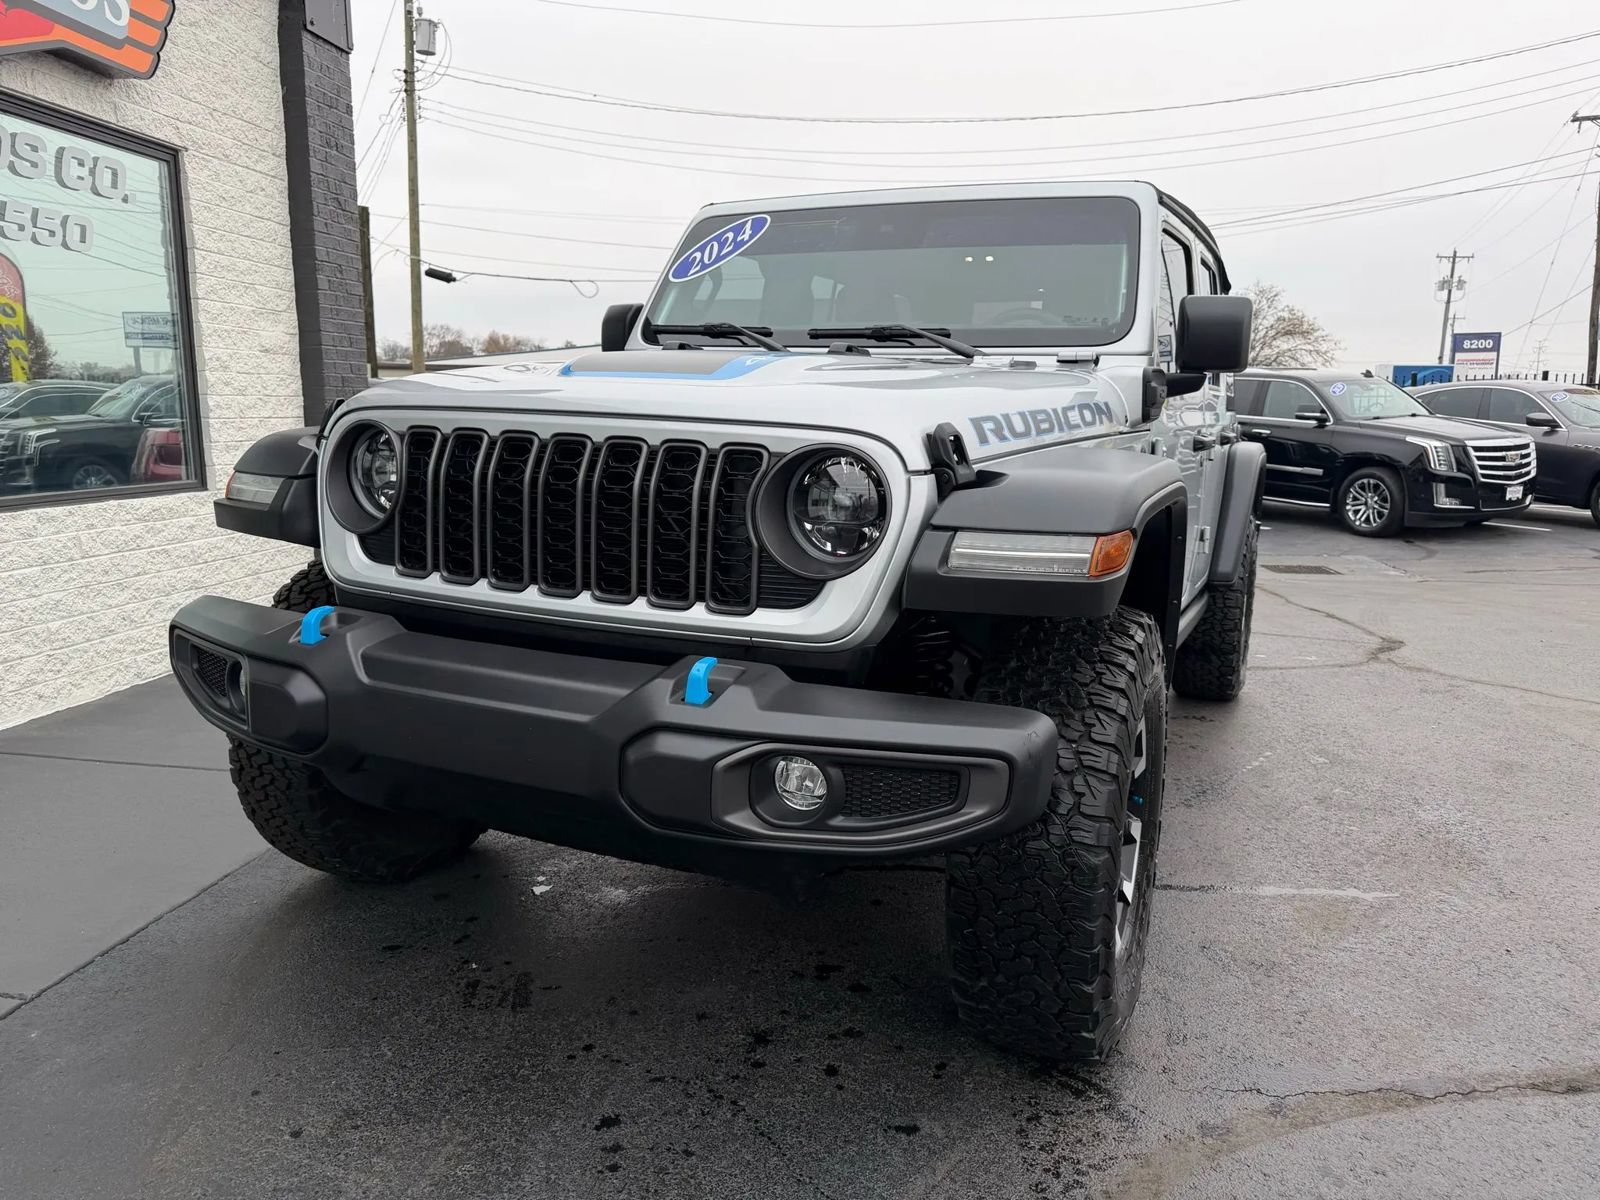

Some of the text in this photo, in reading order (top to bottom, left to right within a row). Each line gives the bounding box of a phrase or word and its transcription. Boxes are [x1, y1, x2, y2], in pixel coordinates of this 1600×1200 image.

[687, 218, 753, 277] 2024
[1462, 338, 1494, 349] 8200
[968, 400, 1114, 447] RUBICON
